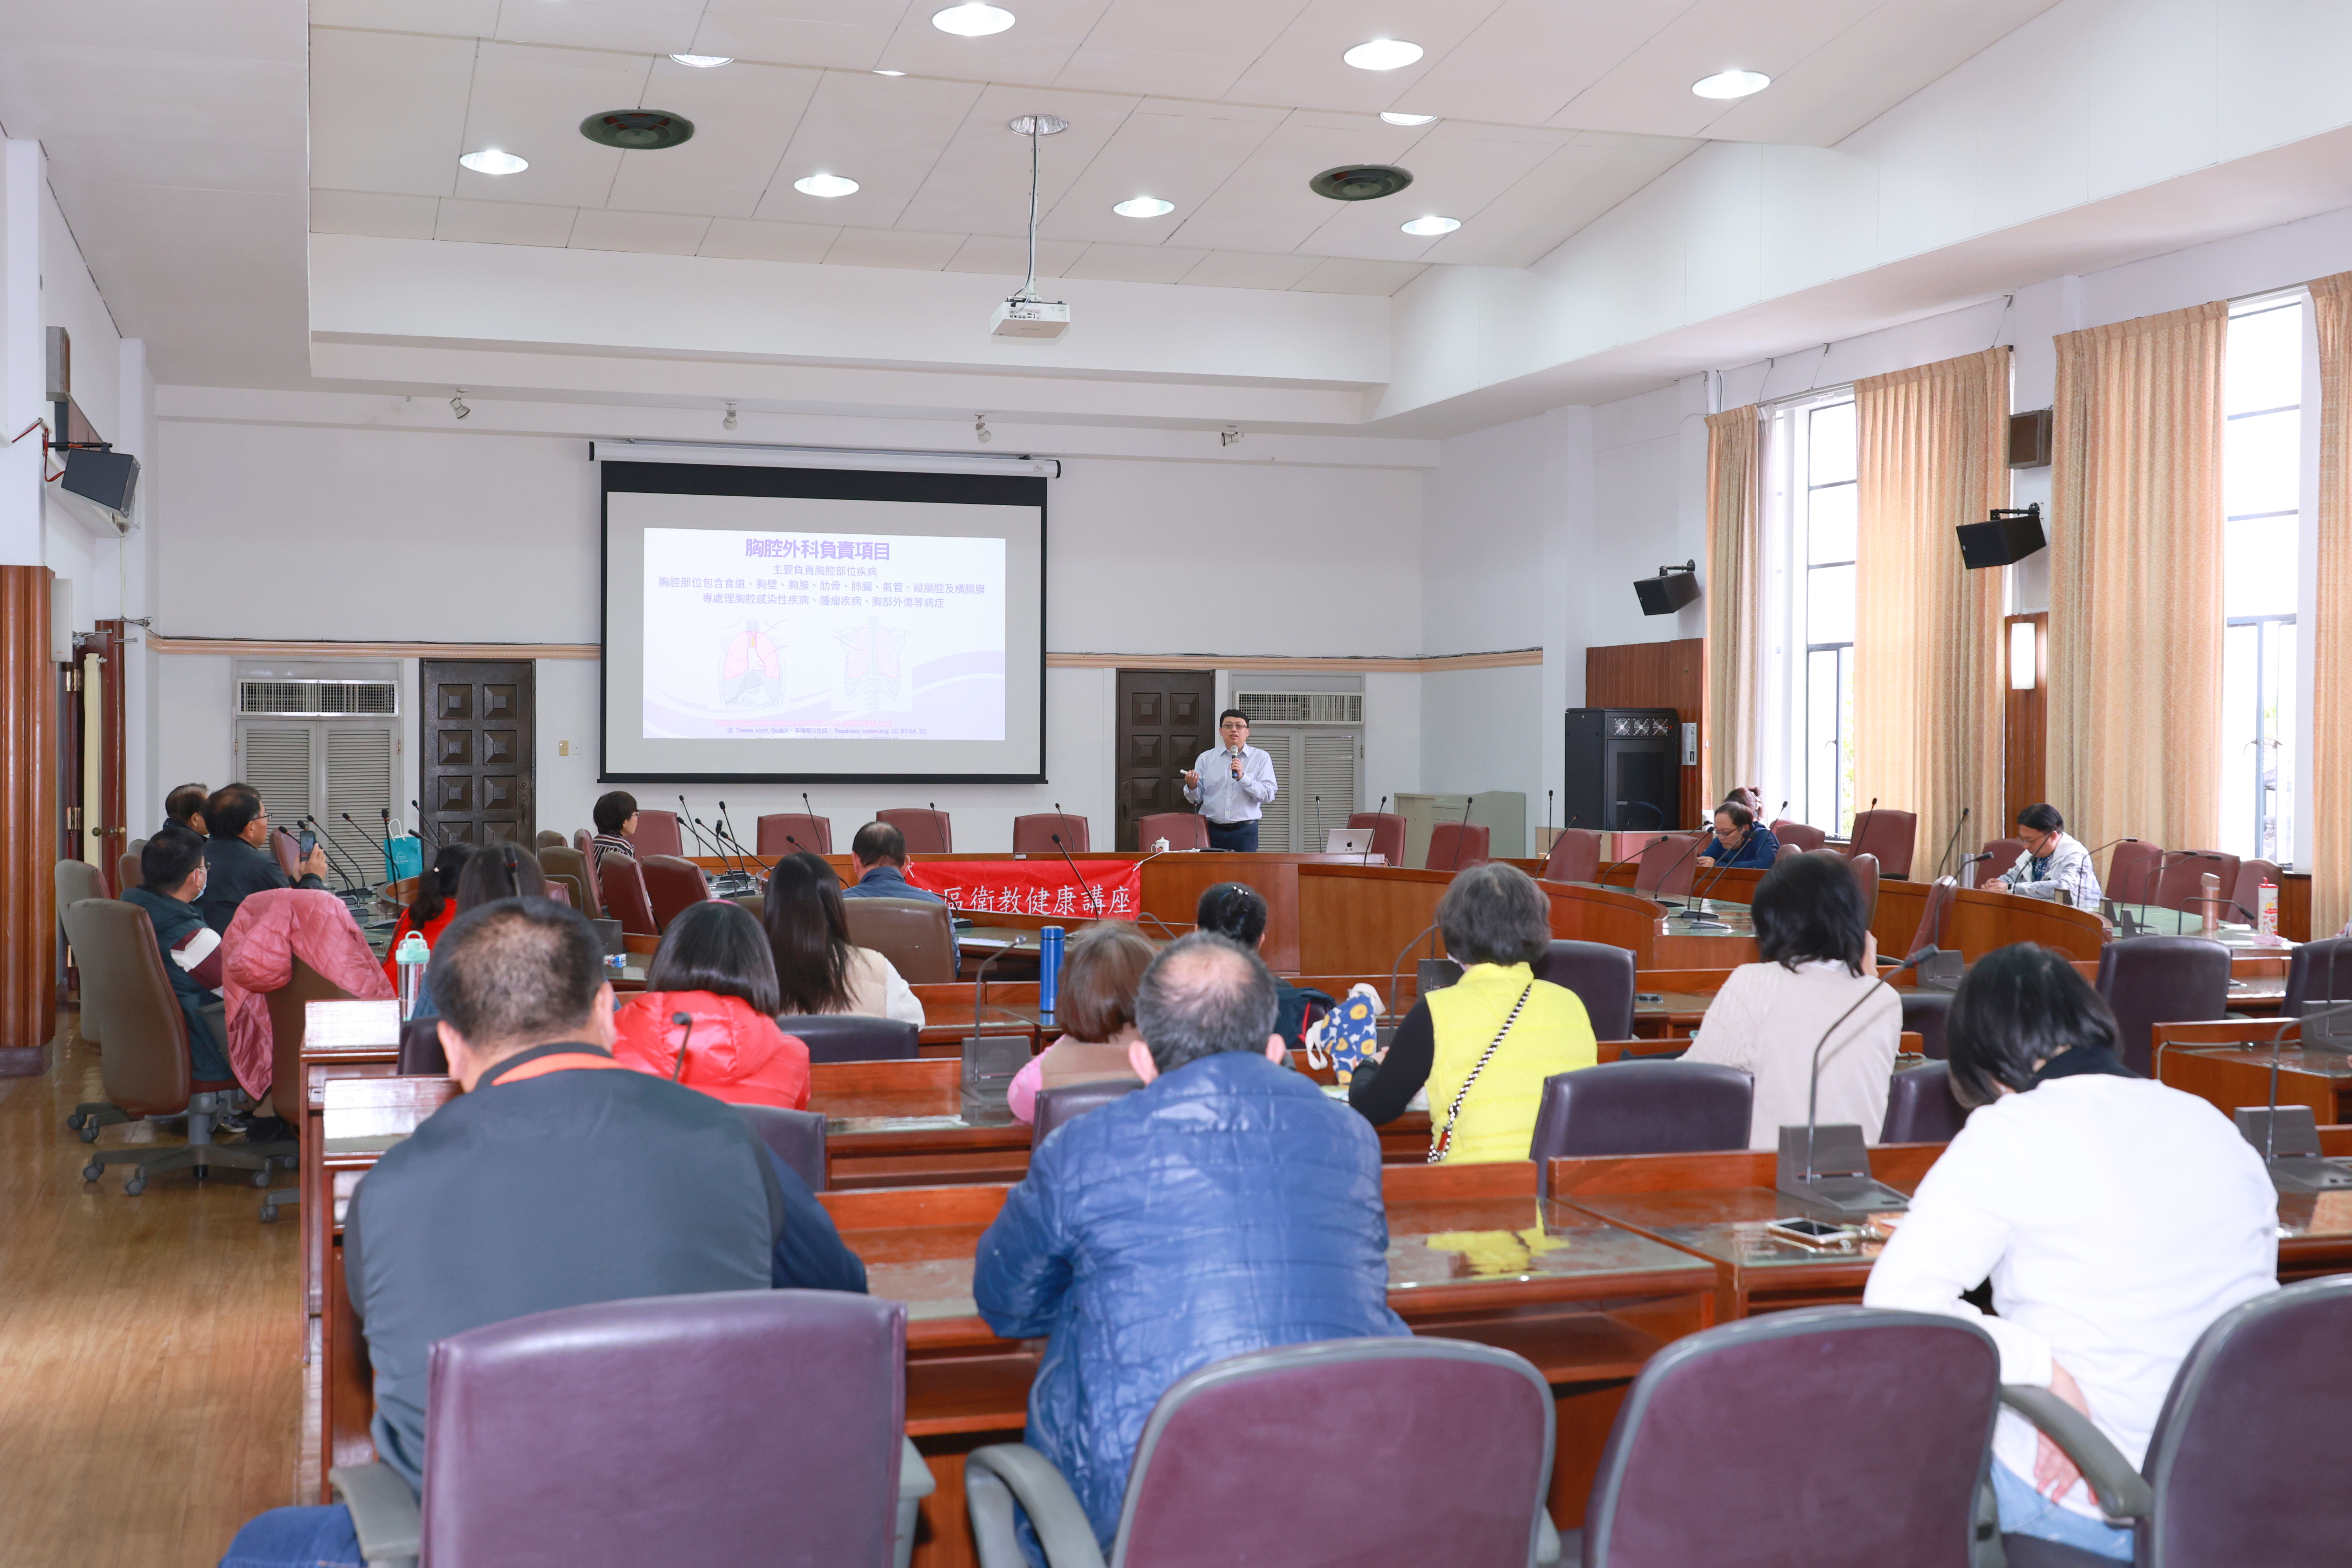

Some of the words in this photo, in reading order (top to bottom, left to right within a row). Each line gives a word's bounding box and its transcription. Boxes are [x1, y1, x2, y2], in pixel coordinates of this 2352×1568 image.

[745, 538, 890, 561] 胸腔外科負責項目
[772, 564, 877, 577] 主要負責胸腔部位疾病
[659, 577, 985, 594] 胸腔部位包含食道、胸壁、胸腺、肋骨、肺臟、氣管、縱膈腔及橫膈膜
[702, 593, 945, 608] 專處理胸腔感染性疾病、腫瘤疾病、胸部外傷等病症
[919, 883, 1132, 916] 區衛教健康講座
